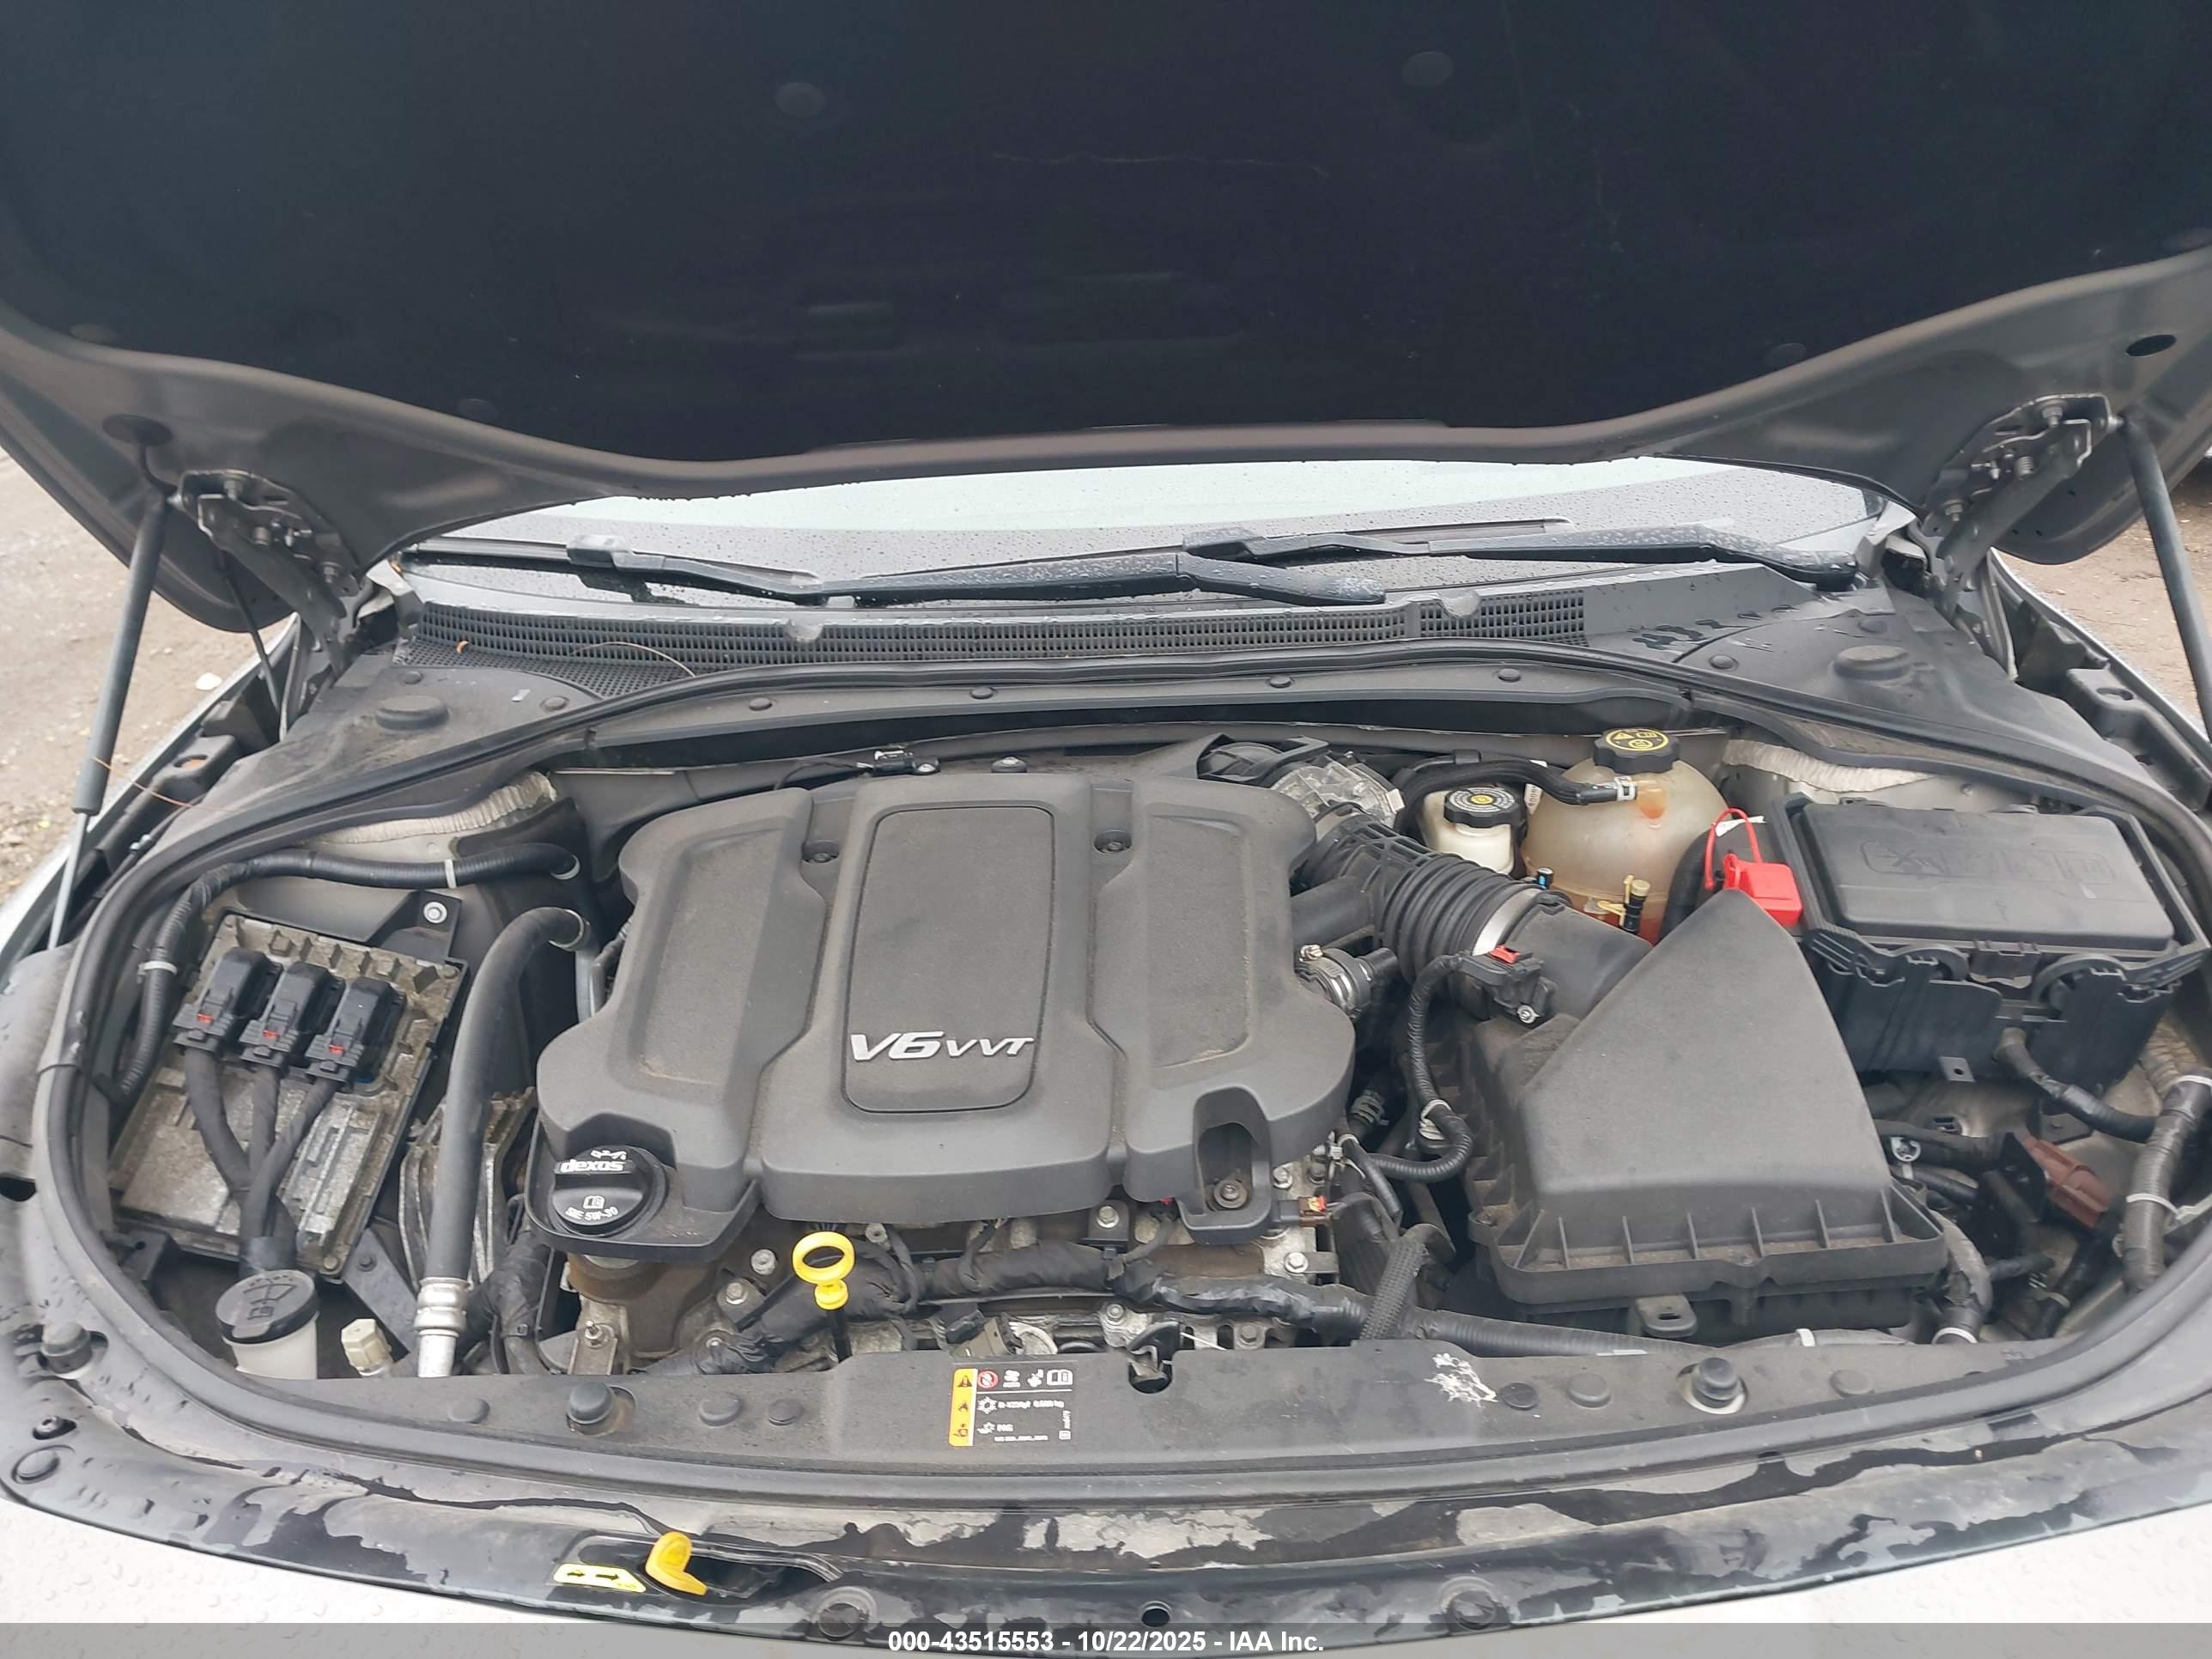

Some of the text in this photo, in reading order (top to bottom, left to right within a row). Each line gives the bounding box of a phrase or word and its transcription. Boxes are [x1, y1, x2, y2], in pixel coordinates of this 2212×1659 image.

[850, 1031, 1035, 1061] V6 VVT
[560, 1158, 626, 1173] dexos
